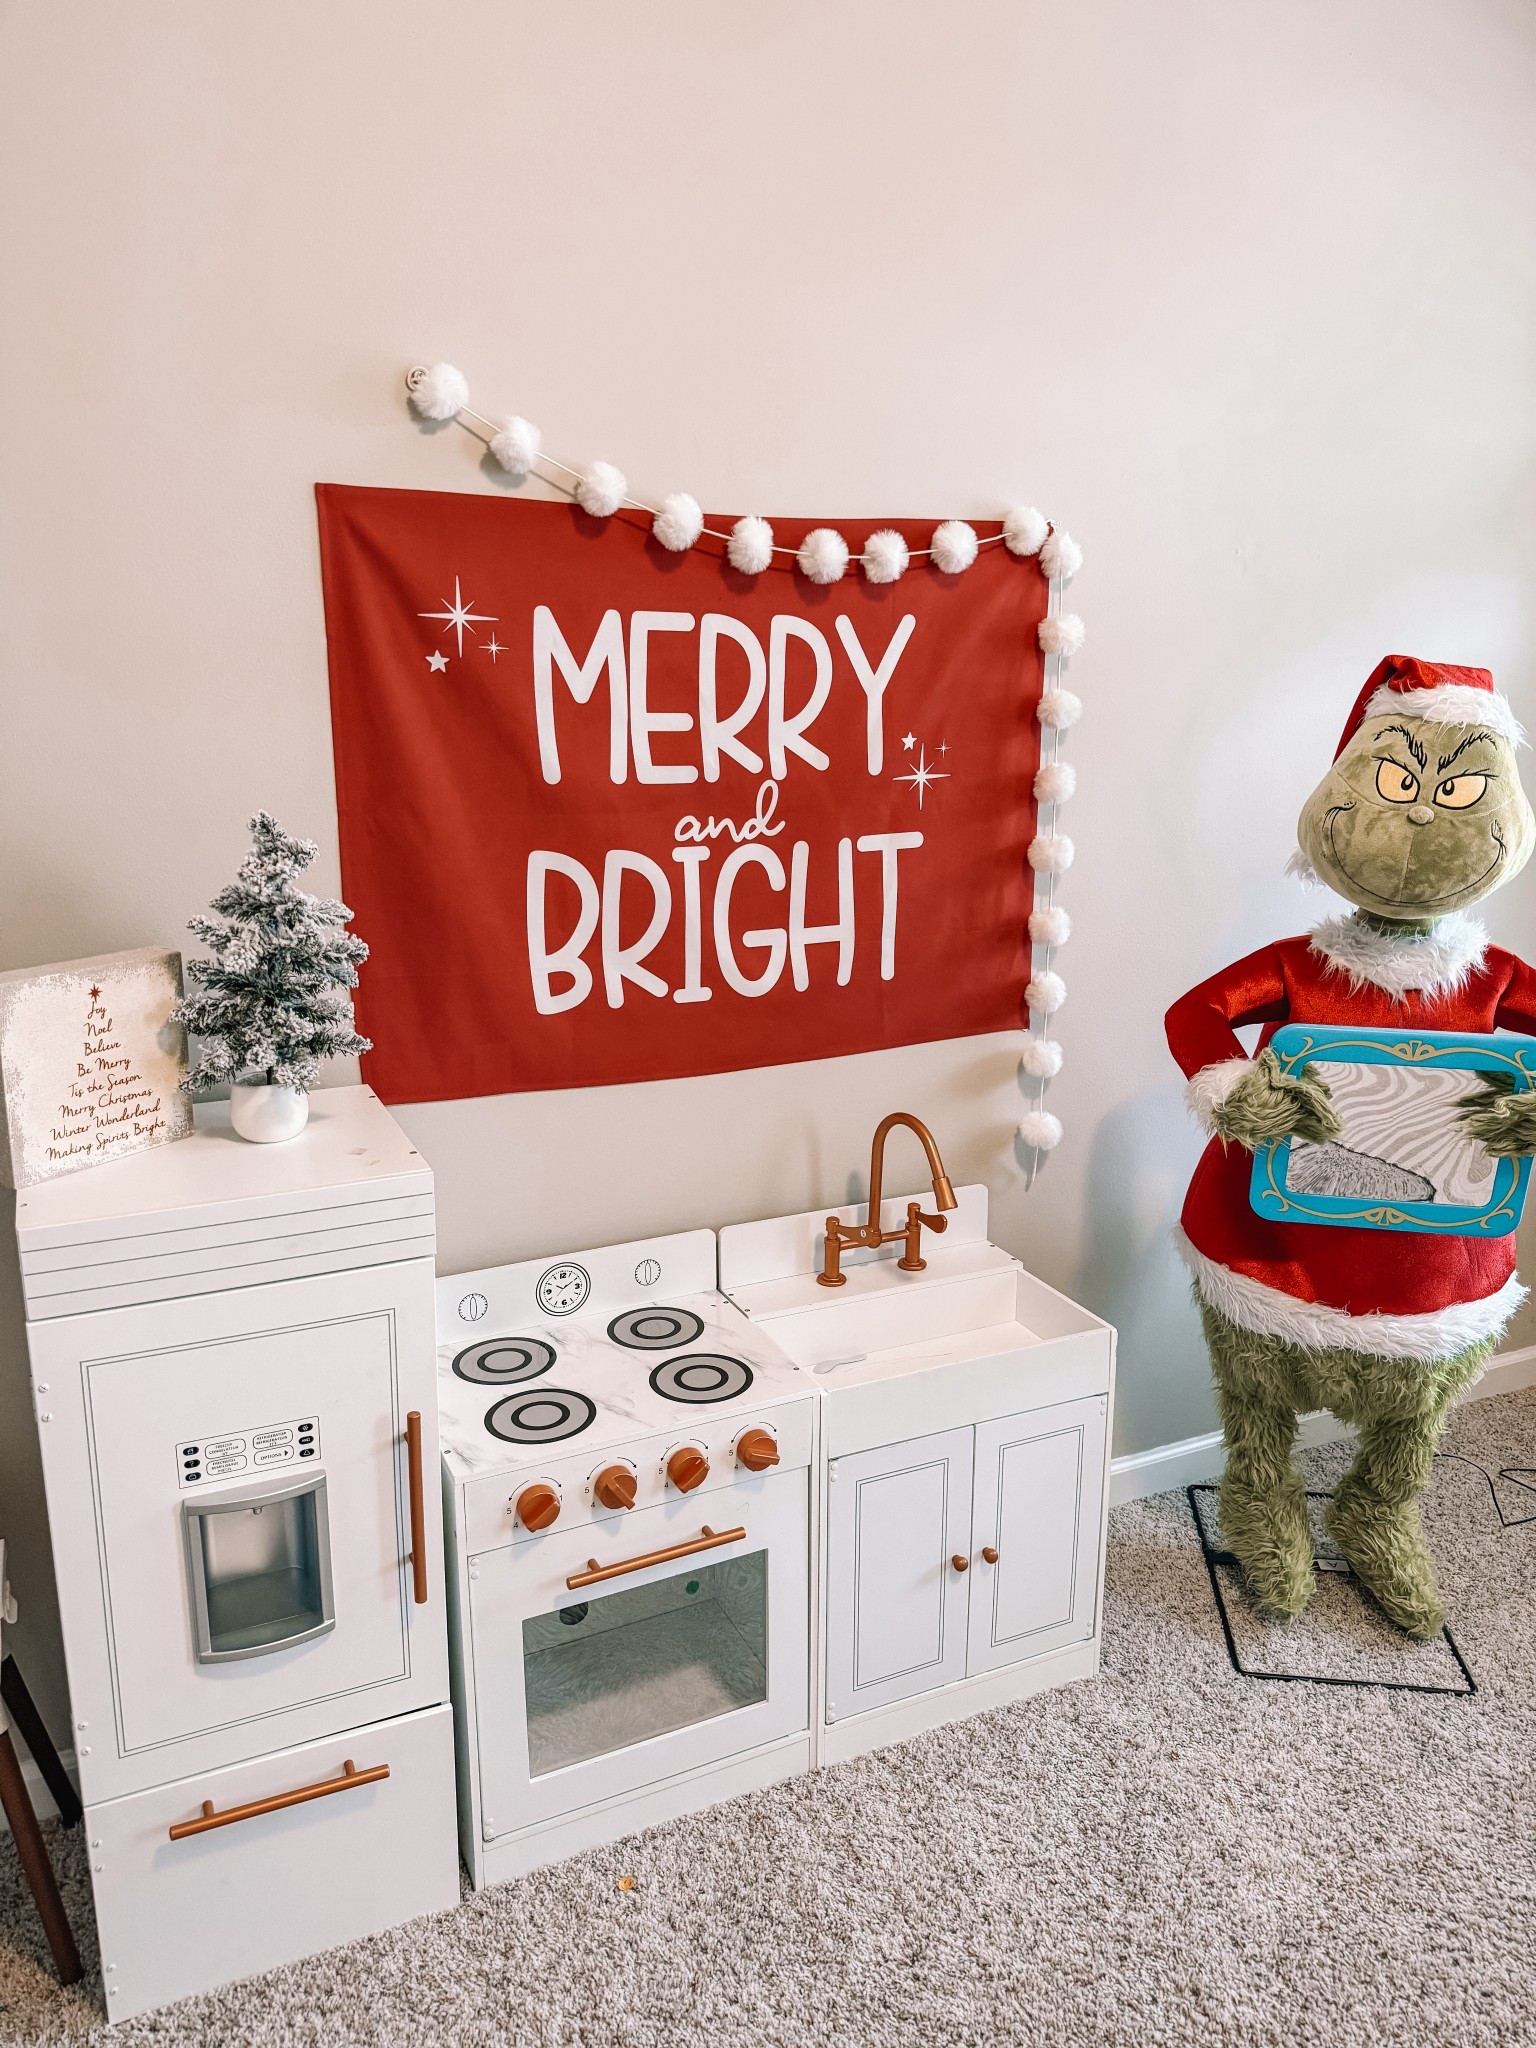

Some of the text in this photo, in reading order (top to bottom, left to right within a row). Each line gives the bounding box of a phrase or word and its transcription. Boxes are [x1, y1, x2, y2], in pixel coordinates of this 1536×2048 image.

[533, 606, 916, 784] MERRY
[674, 780, 786, 843] and
[526, 831, 924, 1015] BRIGHT
[87, 1000, 108, 1020] Joy
[83, 1018, 113, 1037] Noel
[83, 1038, 122, 1057] Believe
[77, 1057, 132, 1078] Be Merry
[86, 1079, 104, 1094] the
[106, 1073, 143, 1092] Season
[58, 1088, 154, 1118] Merry Christmas
[49, 1098, 161, 1141] Winter Wonderland
[45, 1116, 167, 1161] Making Spirits Bright
[728, 1449, 734, 1457] 5
[658, 1467, 664, 1475] 5
[584, 1486, 590, 1494] 5
[506, 1507, 512, 1515] 5
